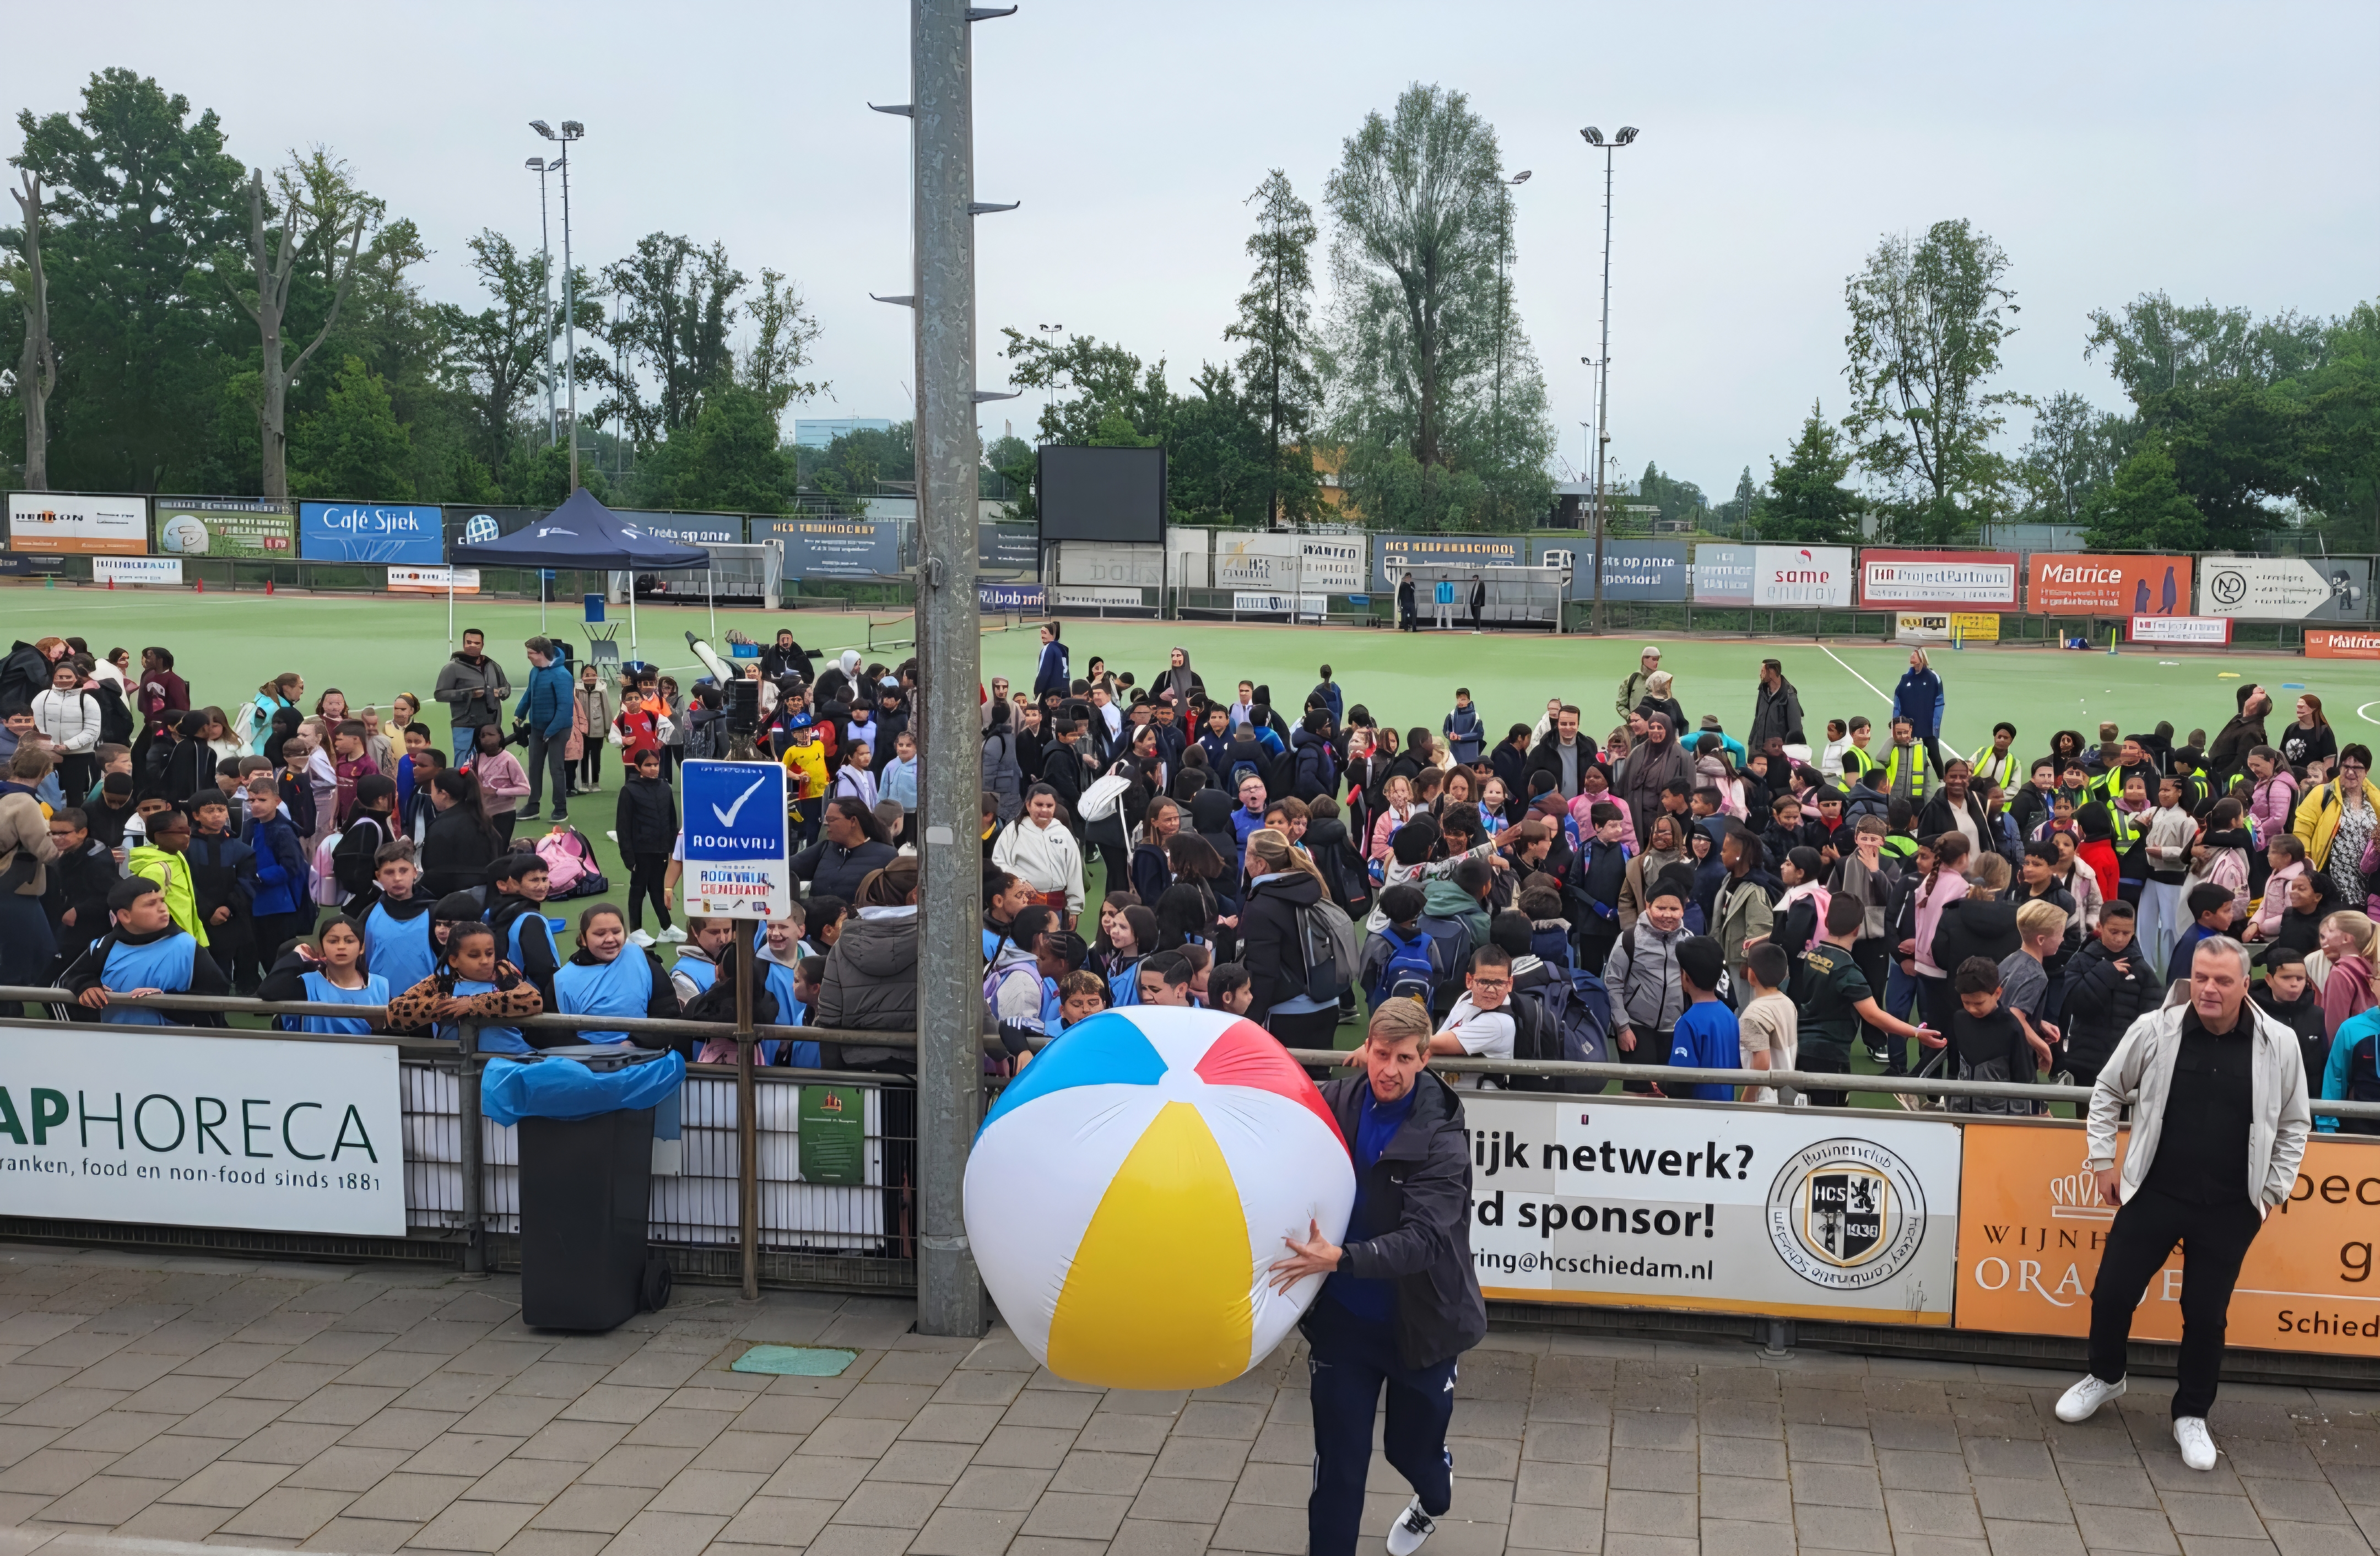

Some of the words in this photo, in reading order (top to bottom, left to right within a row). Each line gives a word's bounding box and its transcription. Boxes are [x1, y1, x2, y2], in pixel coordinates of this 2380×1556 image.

[2041, 563, 2122, 584] Matrice
[693, 834, 776, 850] ROOKVRIJ
[1543, 1139, 1754, 1181] netwerk?
[82, 1158, 127, 1177] food
[137, 1165, 161, 1180] en
[170, 1166, 265, 1185] non-food
[275, 1169, 329, 1190] sinds
[338, 1173, 381, 1191] 1881
[1815, 1185, 1846, 1202] HCS
[1518, 1202, 1715, 1239] sponsor!
